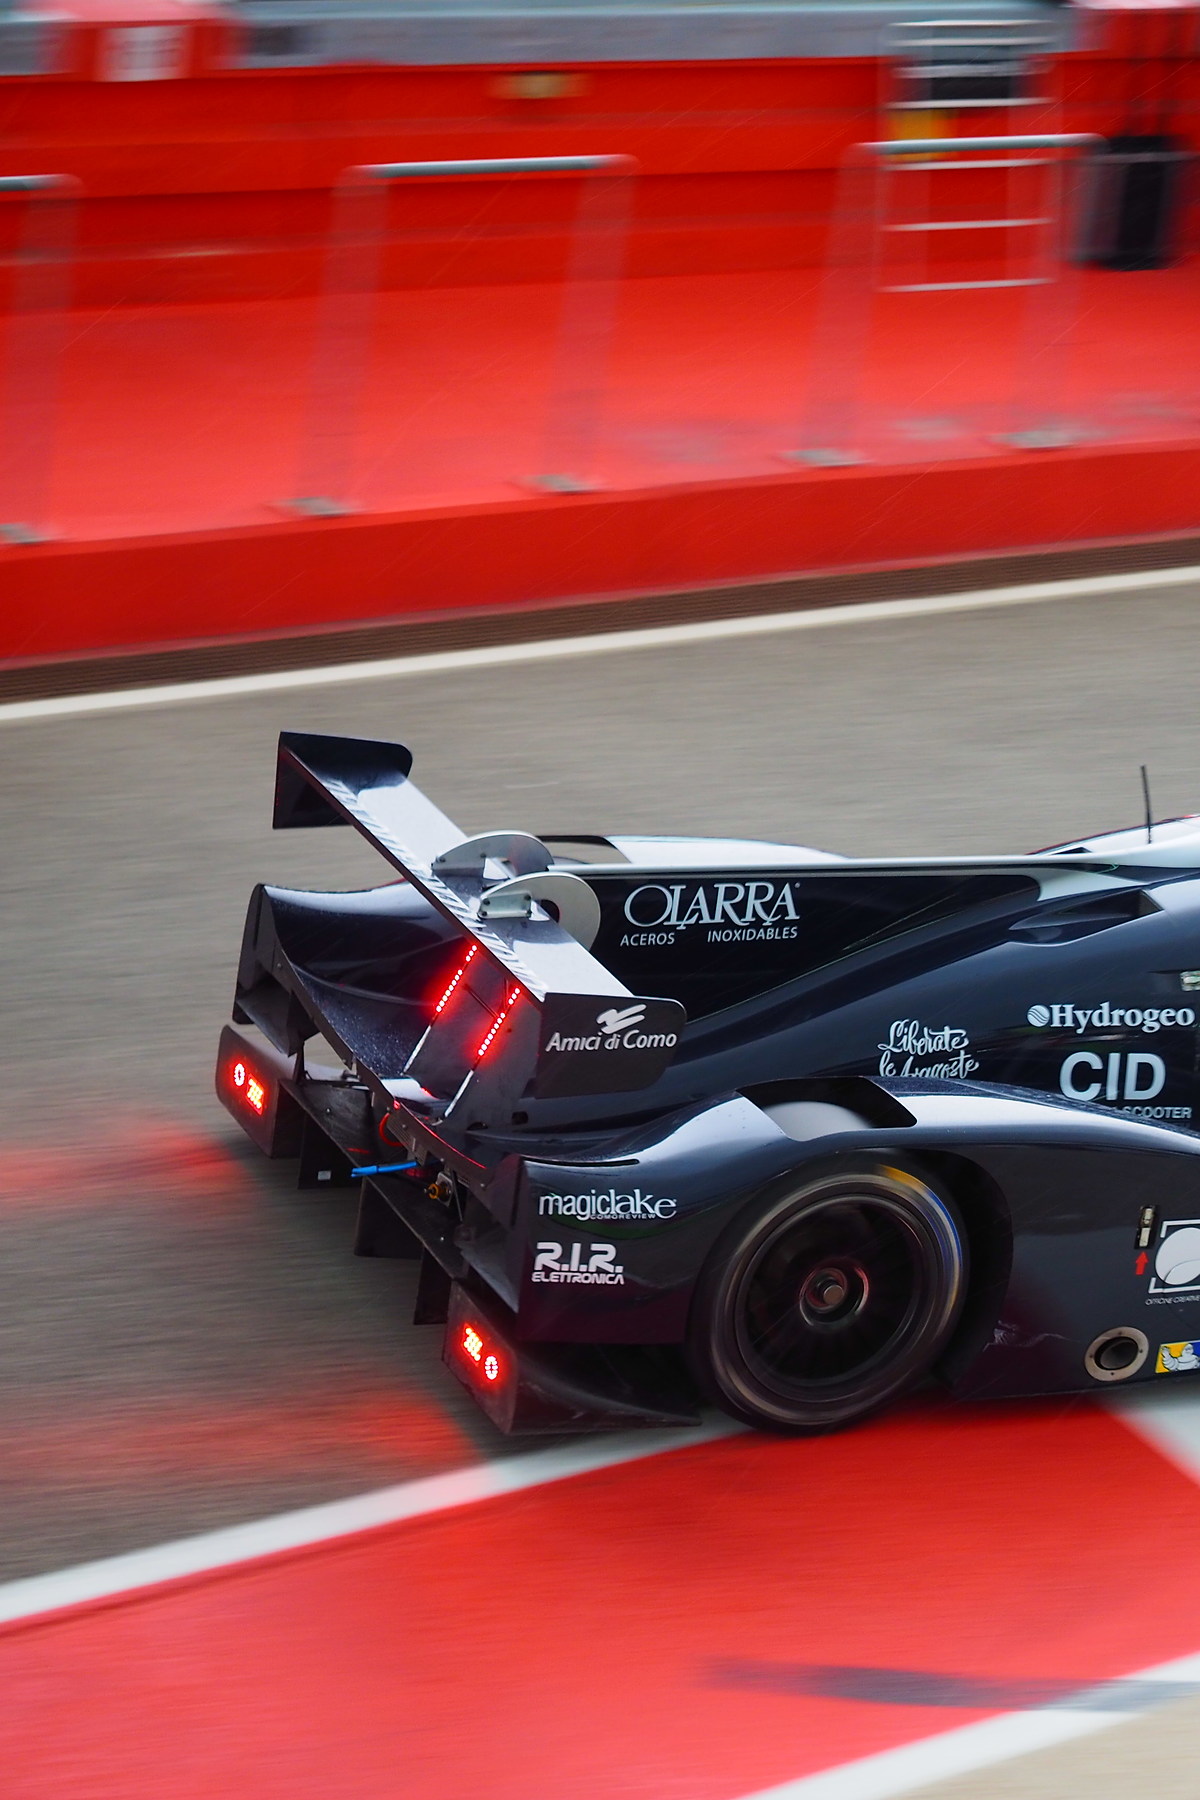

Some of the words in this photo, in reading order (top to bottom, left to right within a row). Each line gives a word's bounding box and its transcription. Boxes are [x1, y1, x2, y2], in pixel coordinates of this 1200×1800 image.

[624, 882, 799, 929] OLARRA
[620, 932, 675, 947] ACEROS
[707, 926, 798, 943] INOXIDABLES
[1050, 1001, 1196, 1035] Hydrogeo
[546, 1031, 602, 1052] Amici
[604, 1030, 620, 1050] di
[622, 1030, 677, 1049] Como
[1060, 1052, 1166, 1101] CID
[1122, 1106, 1192, 1118] SCOOTER
[539, 1188, 677, 1221] magiclake
[534, 1242, 624, 1273] R.I.R.
[532, 1271, 625, 1285] ELETTRONICA
